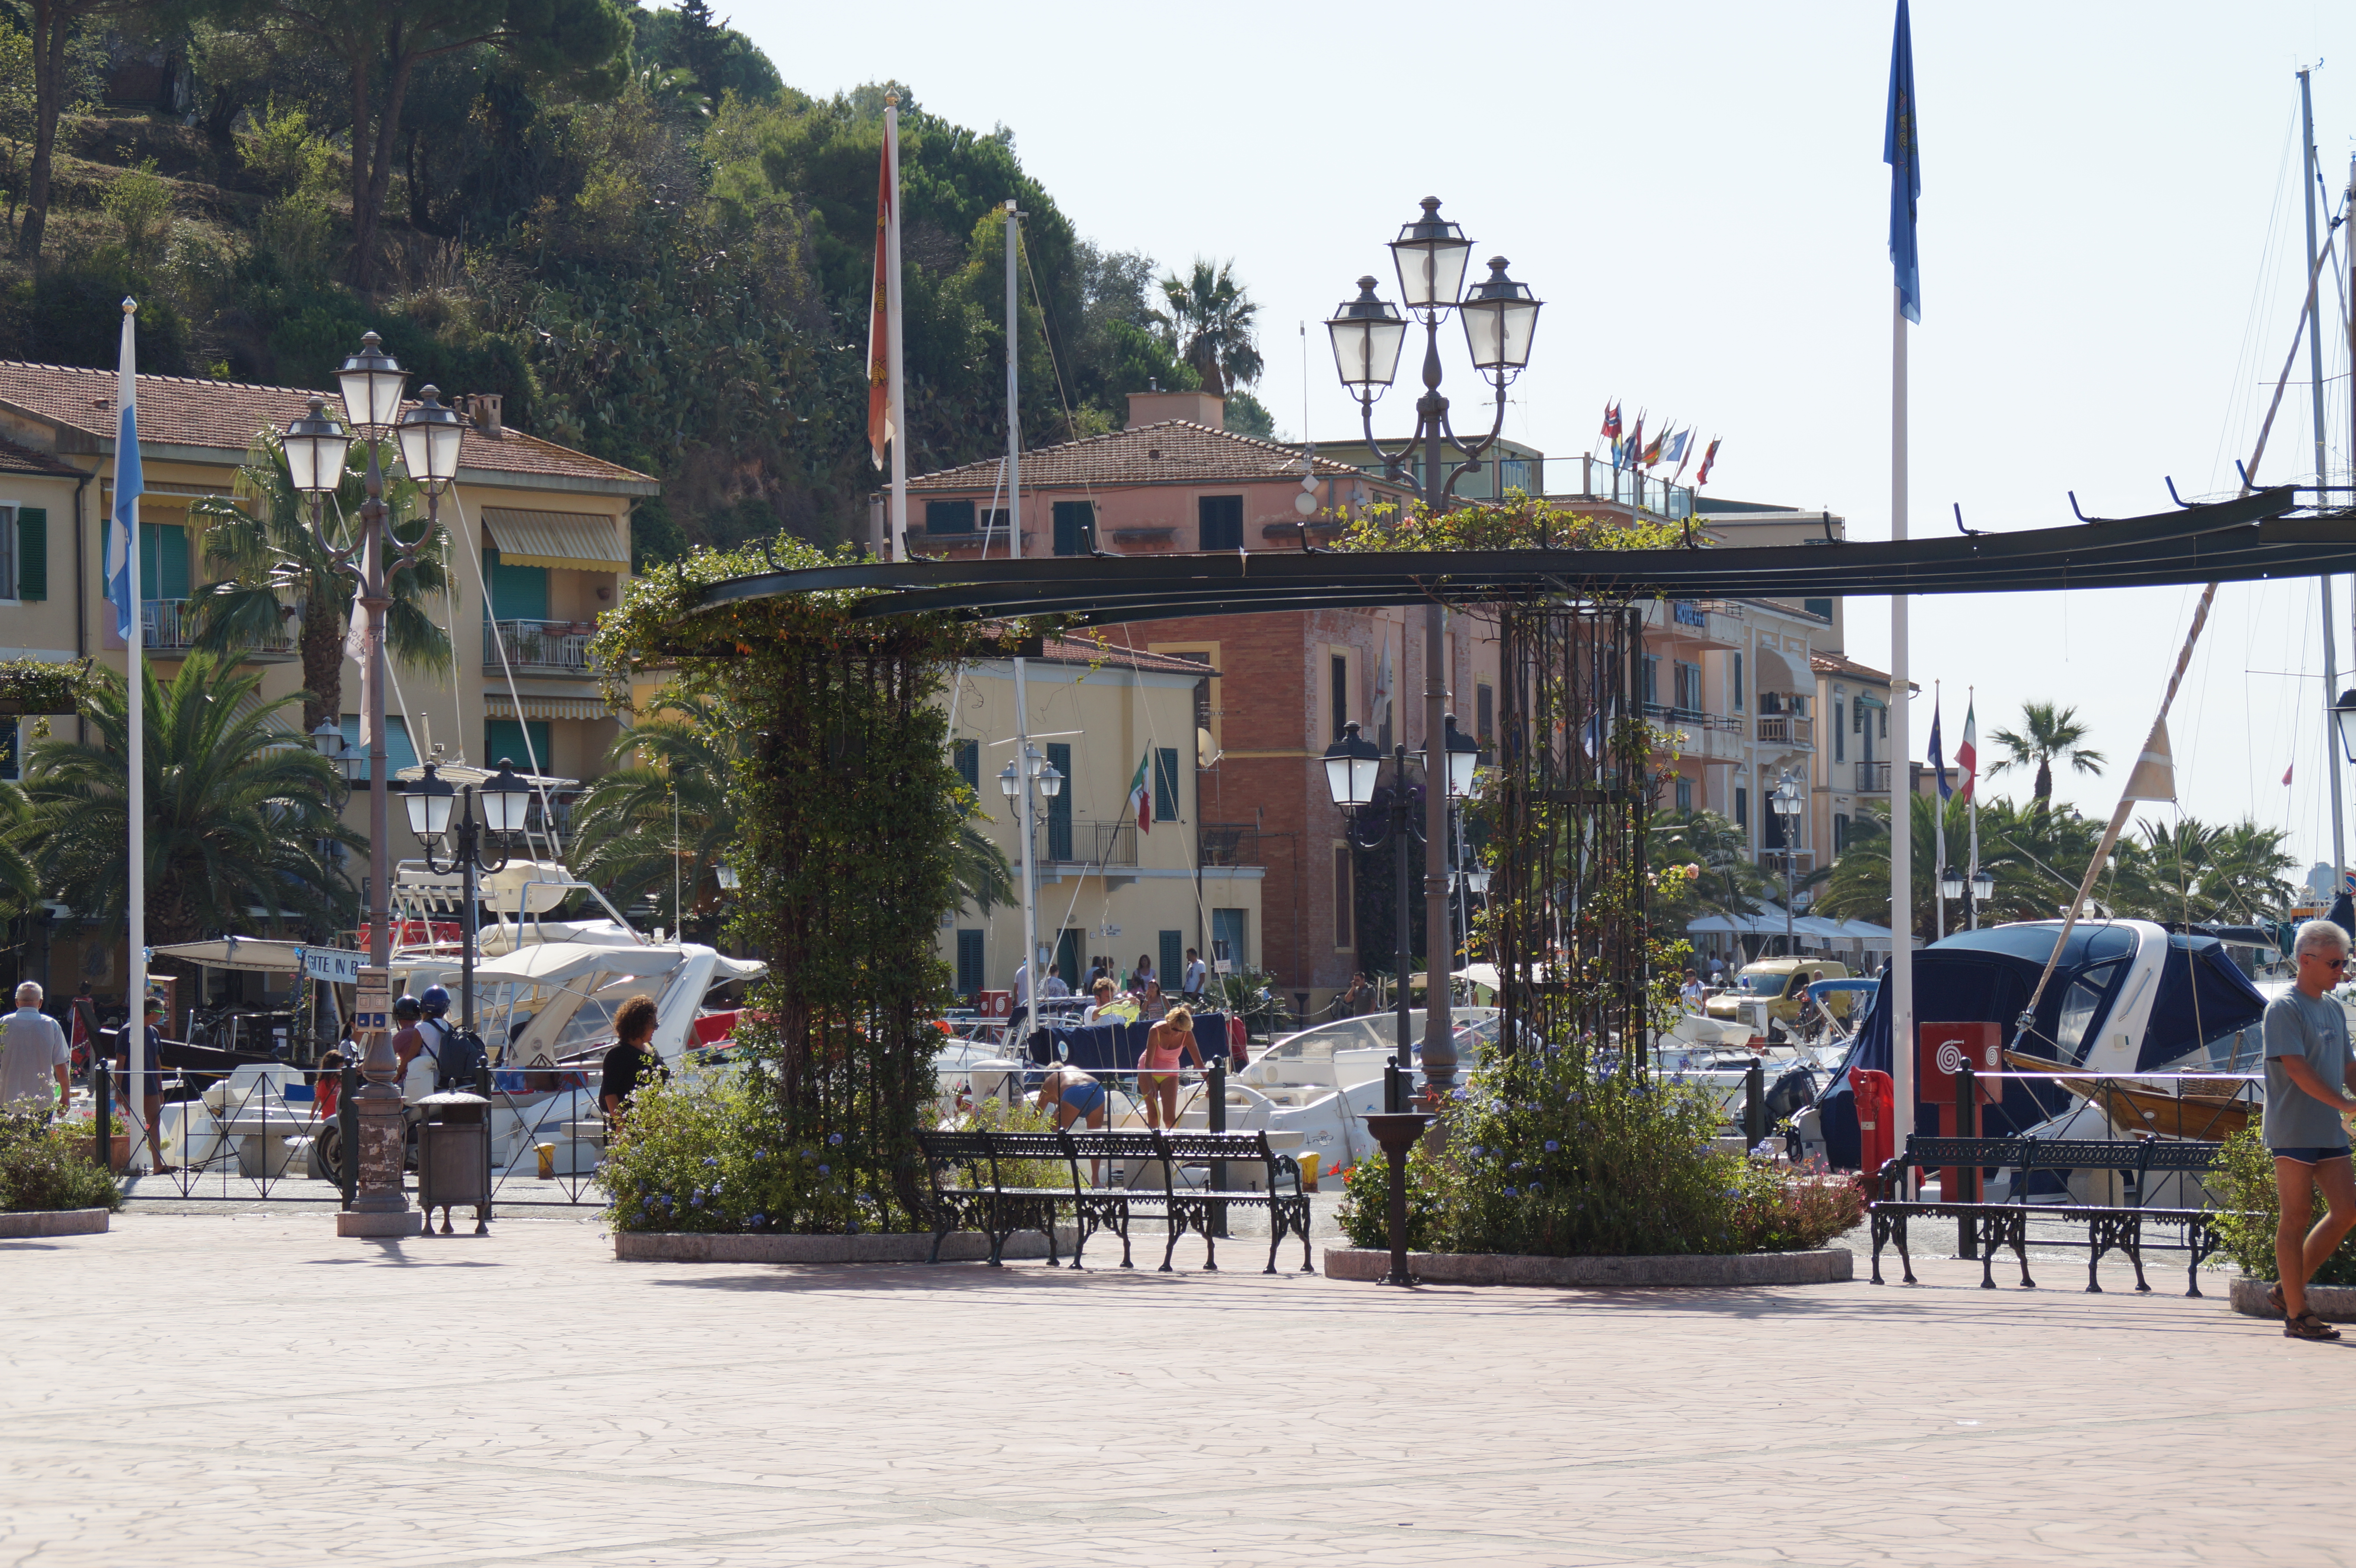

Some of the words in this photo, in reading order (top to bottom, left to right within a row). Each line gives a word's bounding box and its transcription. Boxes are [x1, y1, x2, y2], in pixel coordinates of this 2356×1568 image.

[1677, 603, 1694, 625] HOTEL
[307, 955, 329, 973] GITE
[336, 958, 345, 974] IN
[1311, 1135, 1334, 1143] RIO
